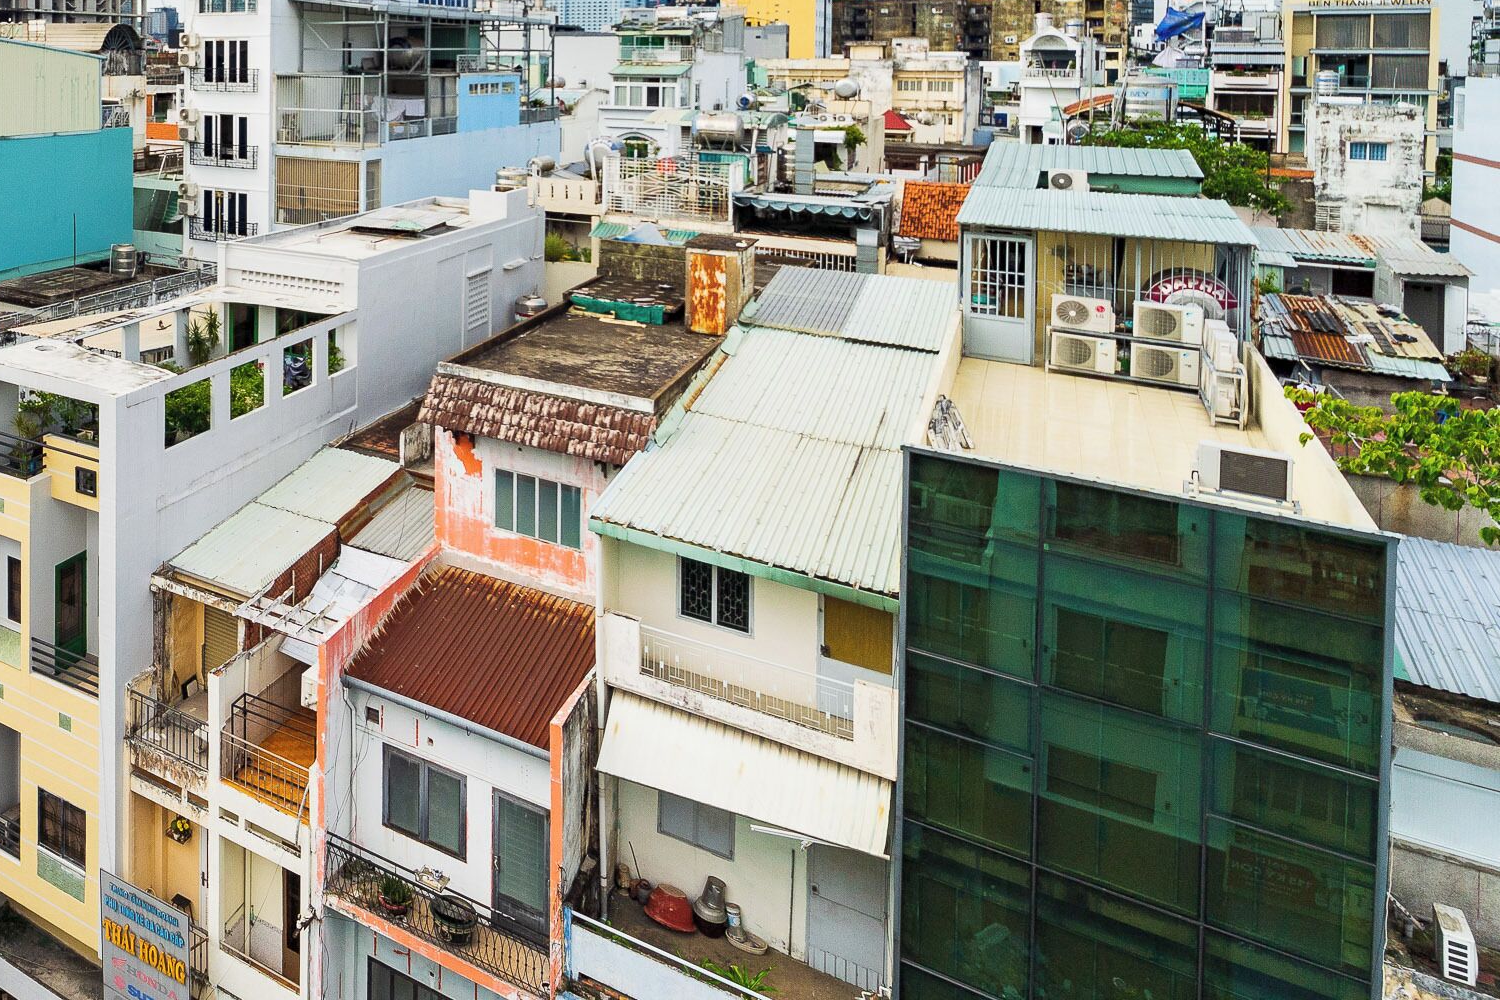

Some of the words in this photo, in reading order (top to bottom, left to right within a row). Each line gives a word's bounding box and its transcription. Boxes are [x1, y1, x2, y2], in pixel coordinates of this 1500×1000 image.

[102, 917, 136, 956] THÁI
[137, 939, 186, 985] HOÀNG
[126, 964, 178, 1000] HONDA
